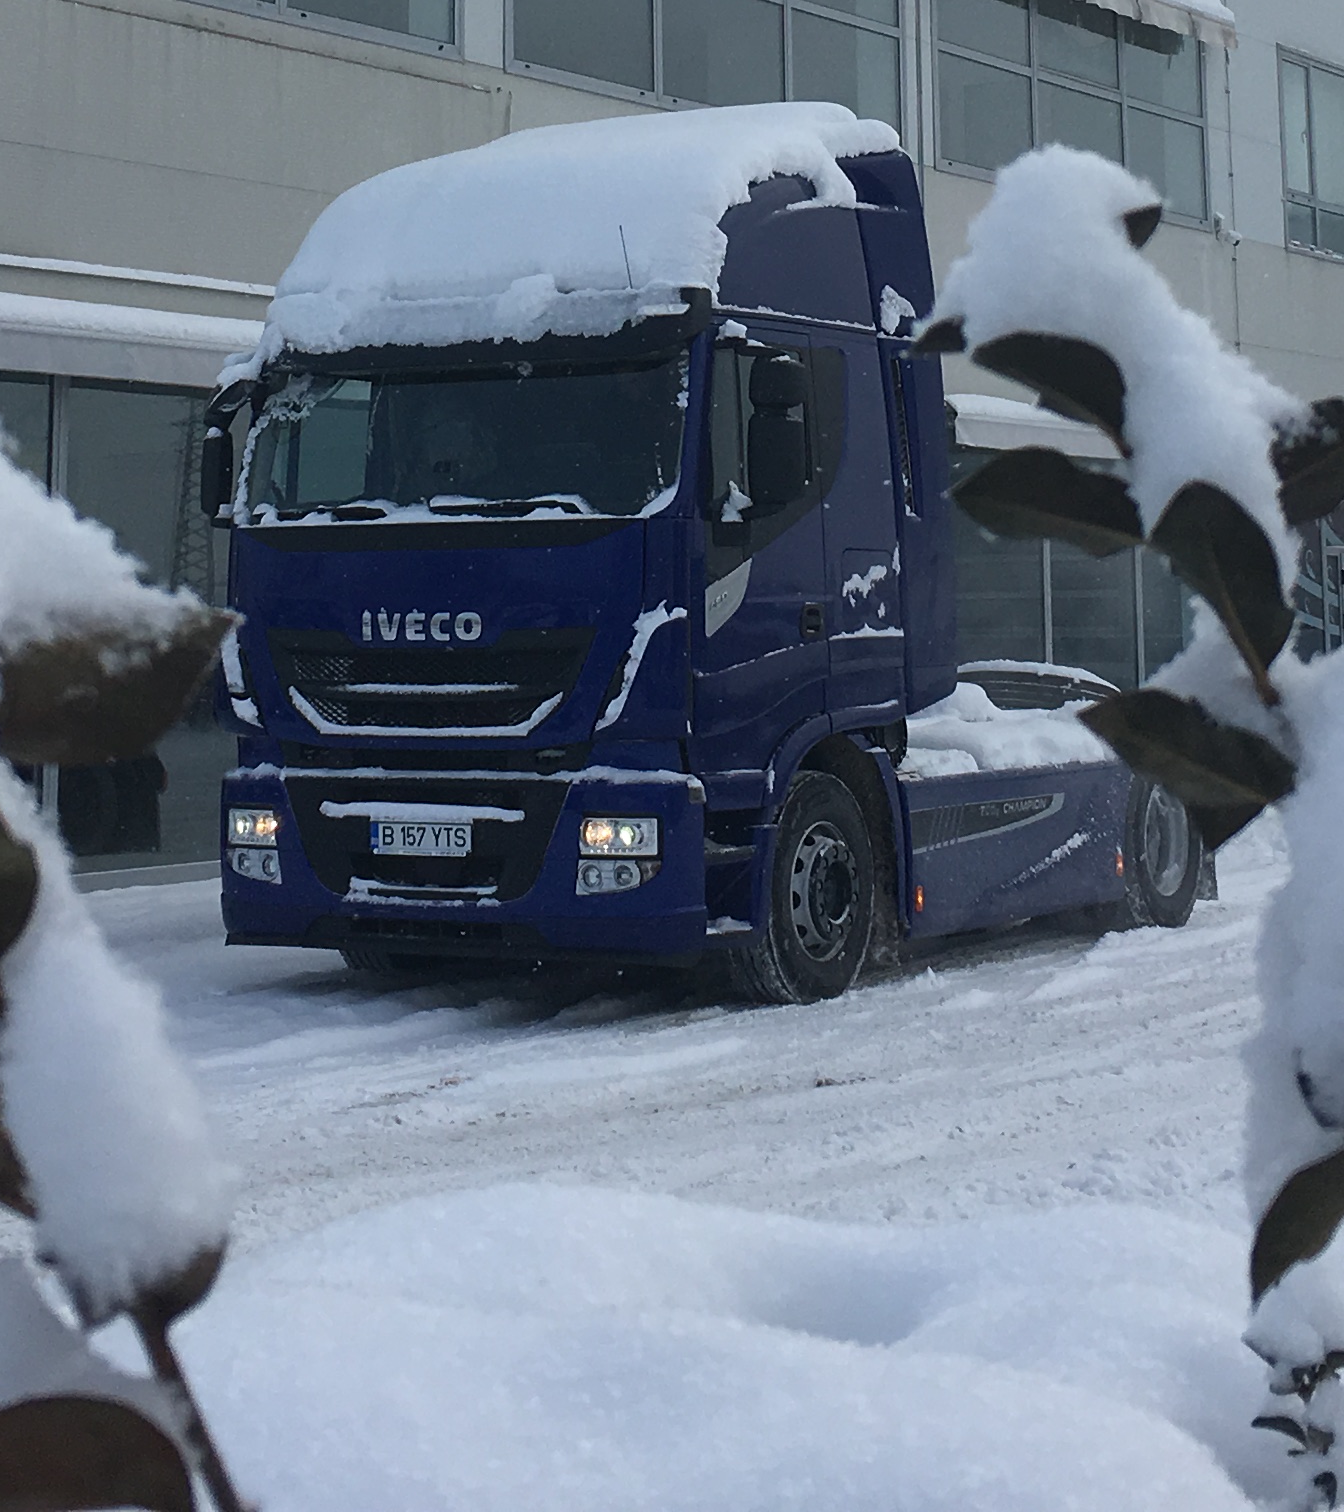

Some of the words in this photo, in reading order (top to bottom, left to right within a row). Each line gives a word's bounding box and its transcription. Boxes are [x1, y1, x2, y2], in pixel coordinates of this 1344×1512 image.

[362, 610, 482, 641] IVECO
[382, 826, 395, 846] B
[401, 826, 427, 847] 157
[431, 826, 467, 848] YTS
